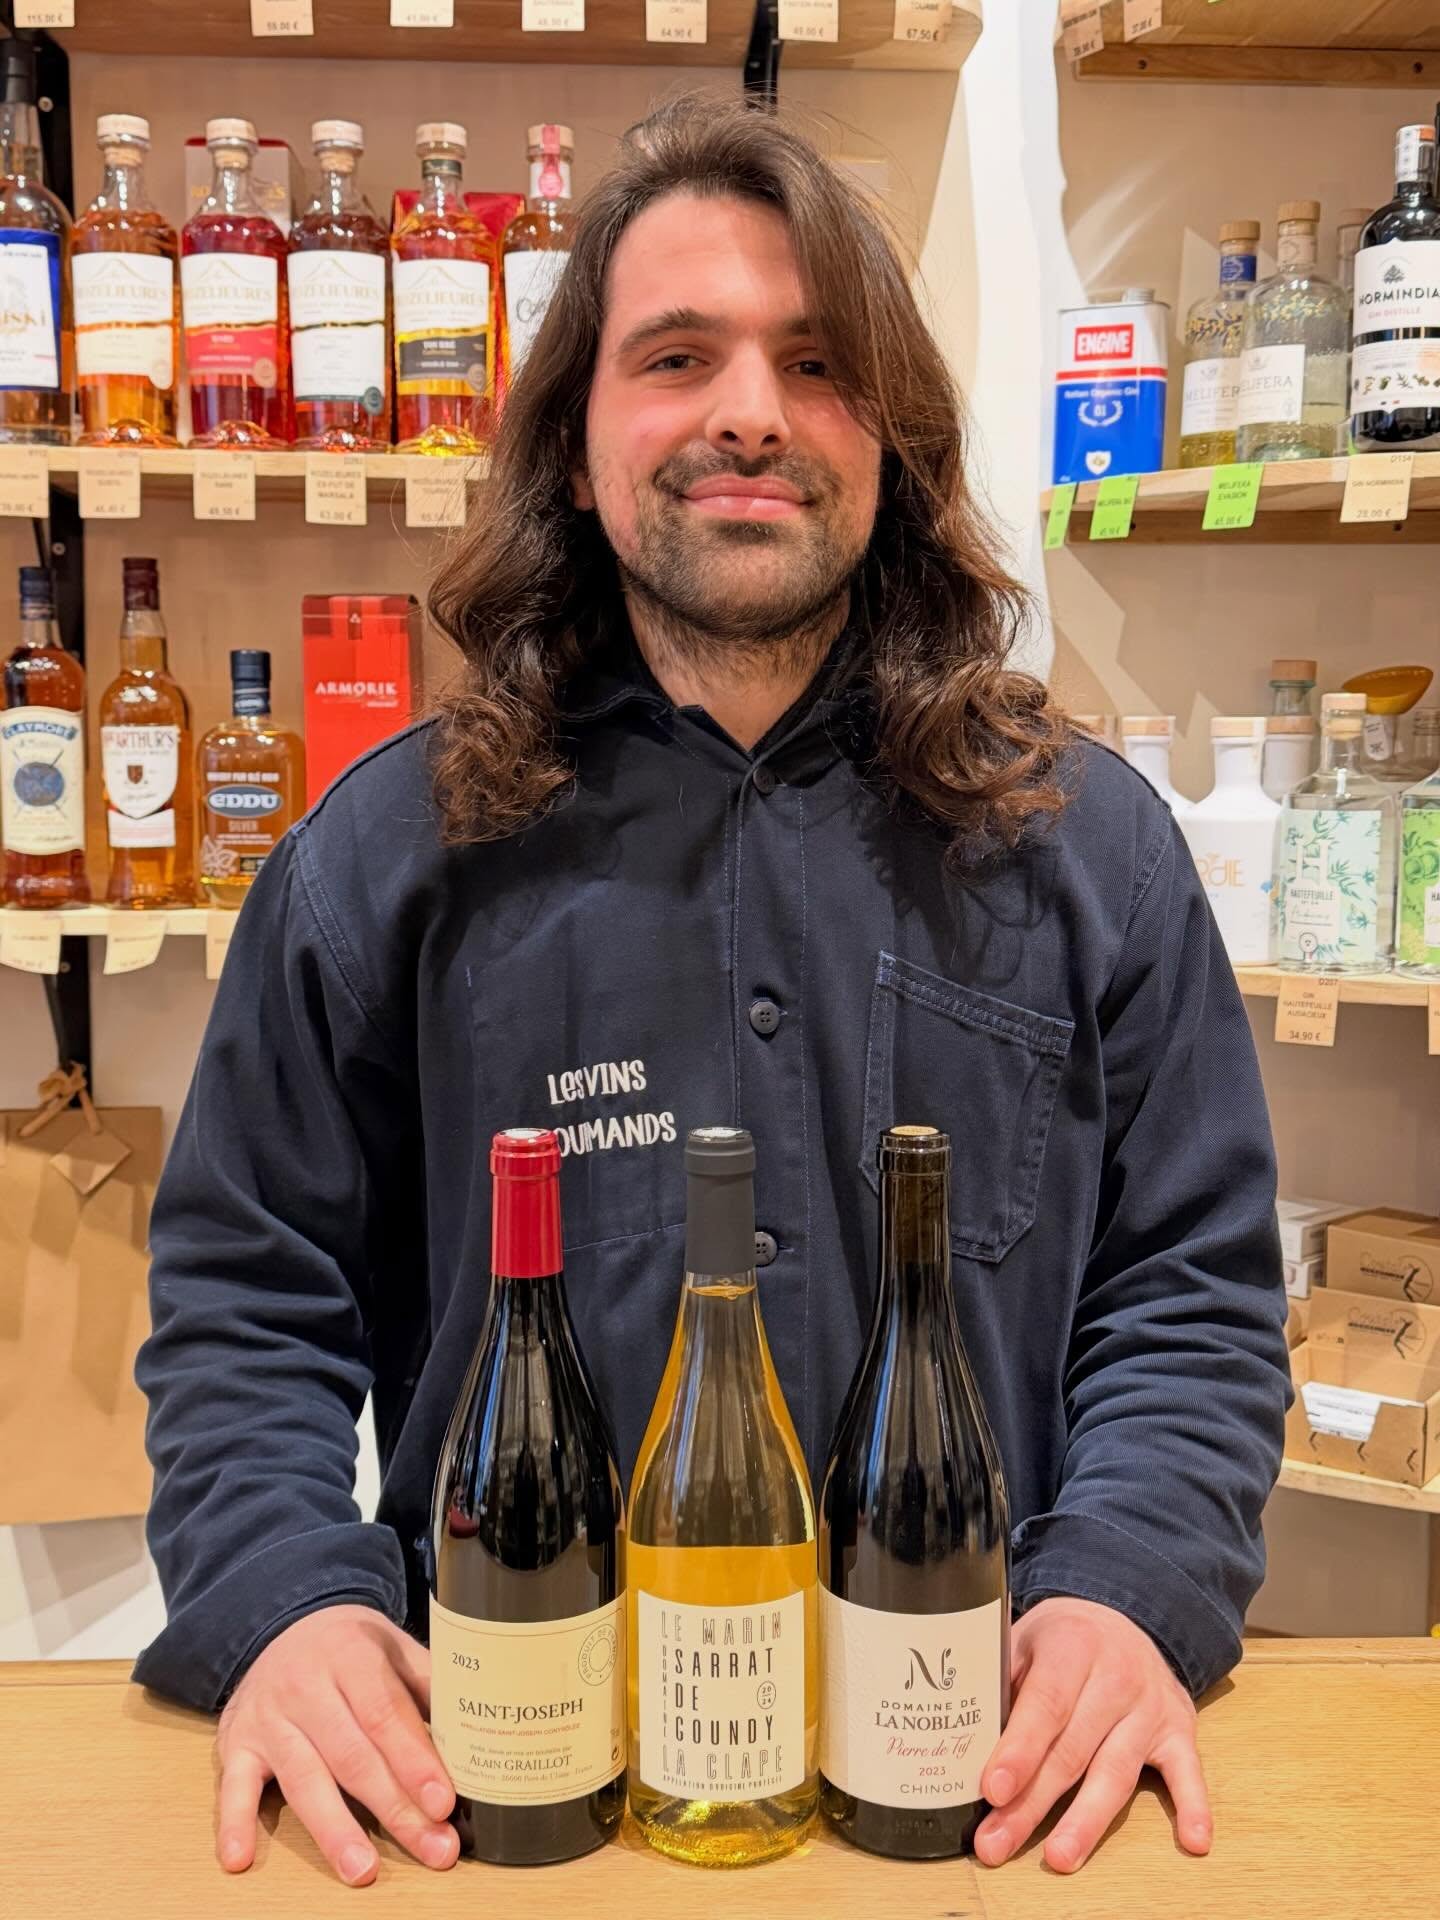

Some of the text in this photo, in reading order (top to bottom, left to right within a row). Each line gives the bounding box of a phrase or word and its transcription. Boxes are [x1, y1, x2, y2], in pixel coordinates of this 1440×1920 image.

[1076, 332, 1131, 356] ENGINE
[314, 681, 398, 697] ARMORIK
[1315, 1032, 1321, 1041] €
[554, 1111, 677, 1158] OUMANDS
[661, 1610, 782, 1646] LE MARIN
[452, 1652, 480, 1672] 2023
[675, 1647, 774, 1679] SARRAT
[675, 1682, 699, 1712] DE
[881, 1697, 978, 1712] DOMAINE DE
[458, 1698, 584, 1724] SAINT-JOSEPH
[874, 1709, 982, 1731] LA NOBLAIE
[675, 1715, 774, 1746] GOUNDY
[887, 1733, 977, 1760] Pierre de Tuf
[504, 1753, 573, 1771] GRAILLOT
[663, 1744, 783, 1780] LA CLAPE
[919, 1767, 946, 1777] 2023
[899, 1780, 965, 1794] CHINON
